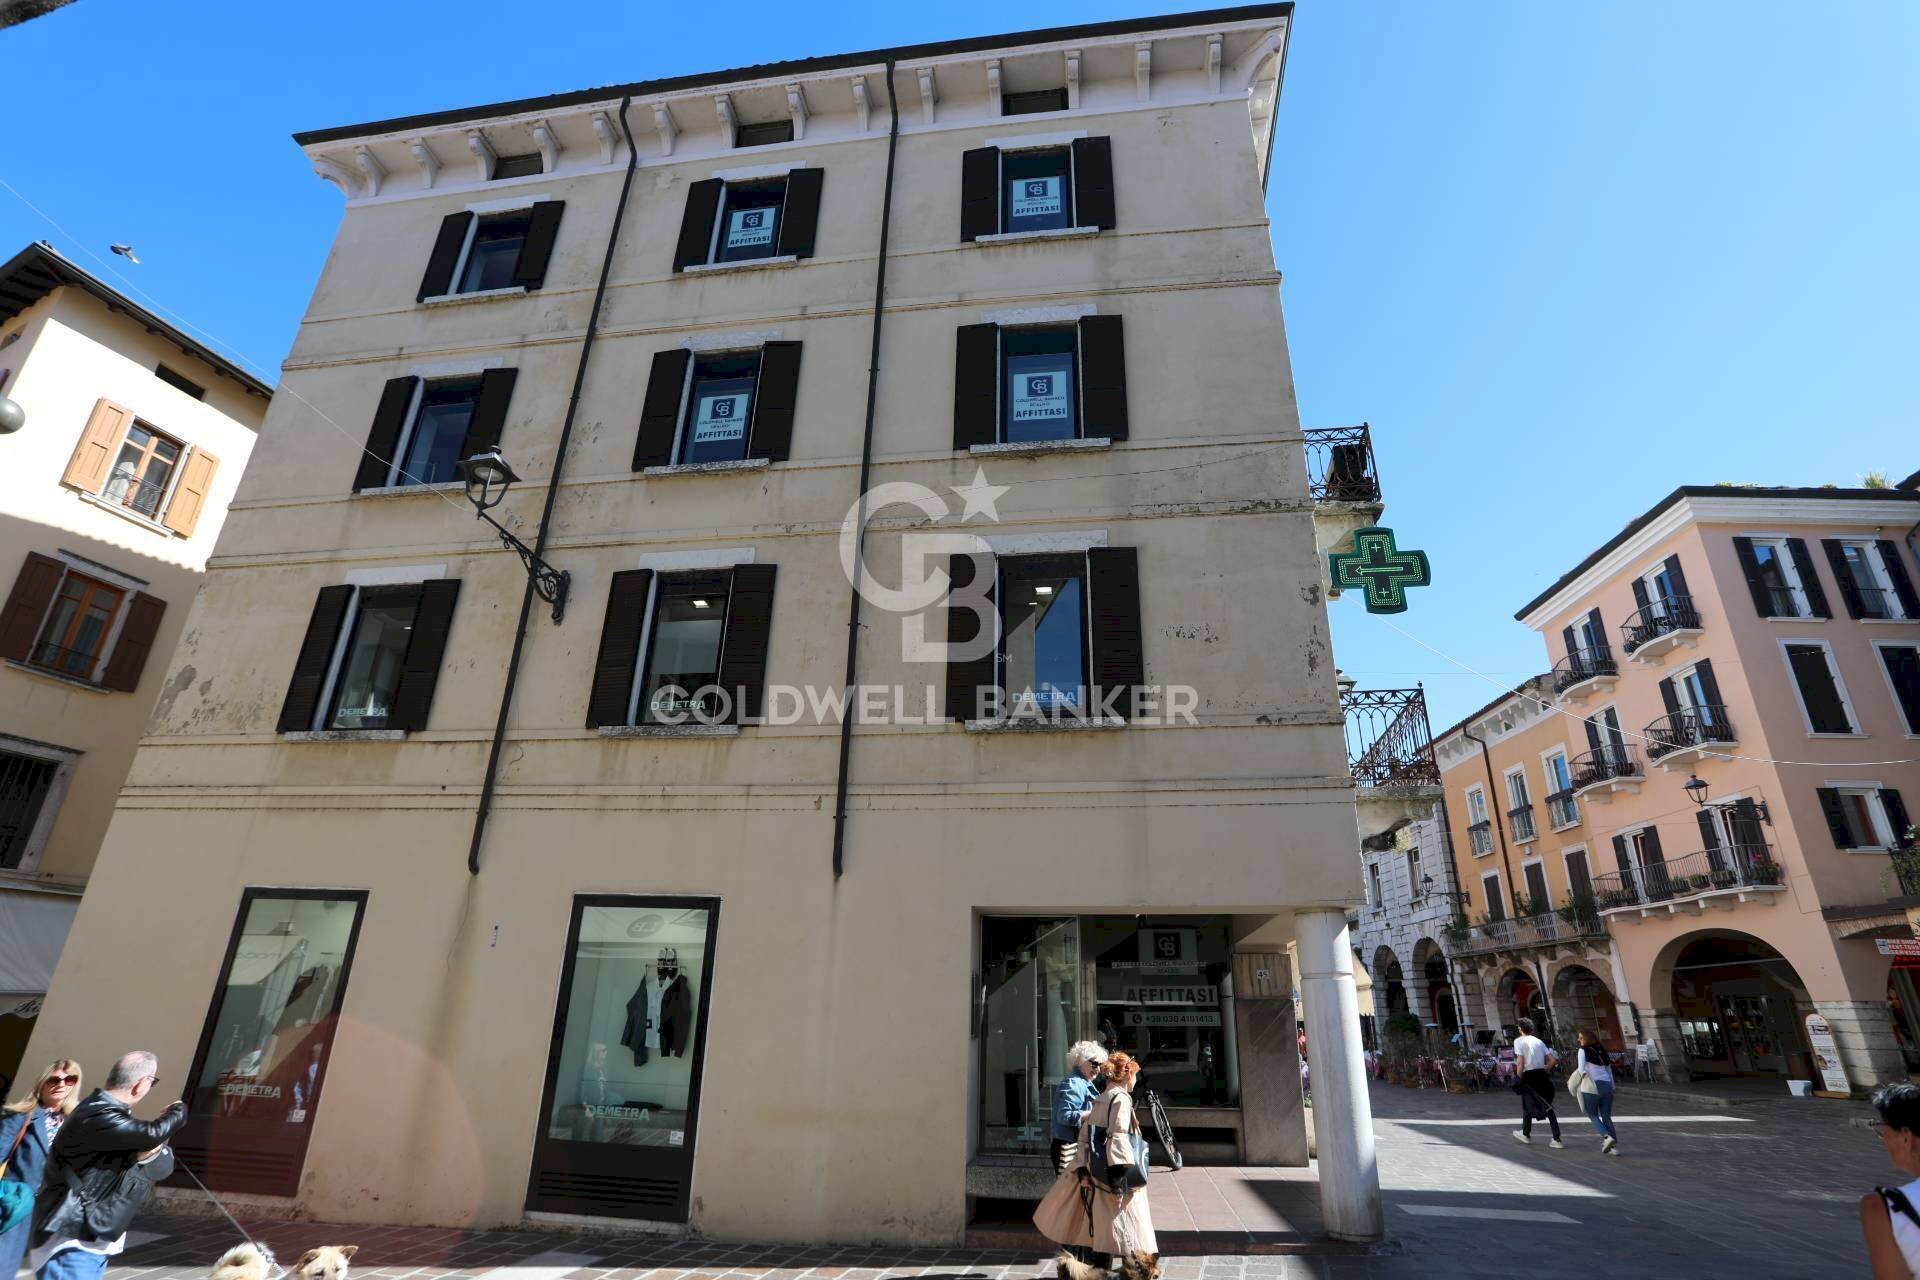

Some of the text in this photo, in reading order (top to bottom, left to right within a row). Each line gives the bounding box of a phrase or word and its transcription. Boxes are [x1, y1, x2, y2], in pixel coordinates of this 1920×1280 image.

[1015, 205, 1059, 215] AFFITTASI
[730, 235, 770, 245] AFFITTASI
[1016, 408, 1065, 418] AFFITTASI
[697, 429, 742, 440] AFFITTASI
[1012, 691, 1077, 703] DEMETRA
[650, 700, 706, 711] DEMETRA
[1127, 988, 1214, 1003] AFFITTASI
[224, 1084, 281, 1098] DEMETRA
[585, 1104, 650, 1120] DEMETRA
